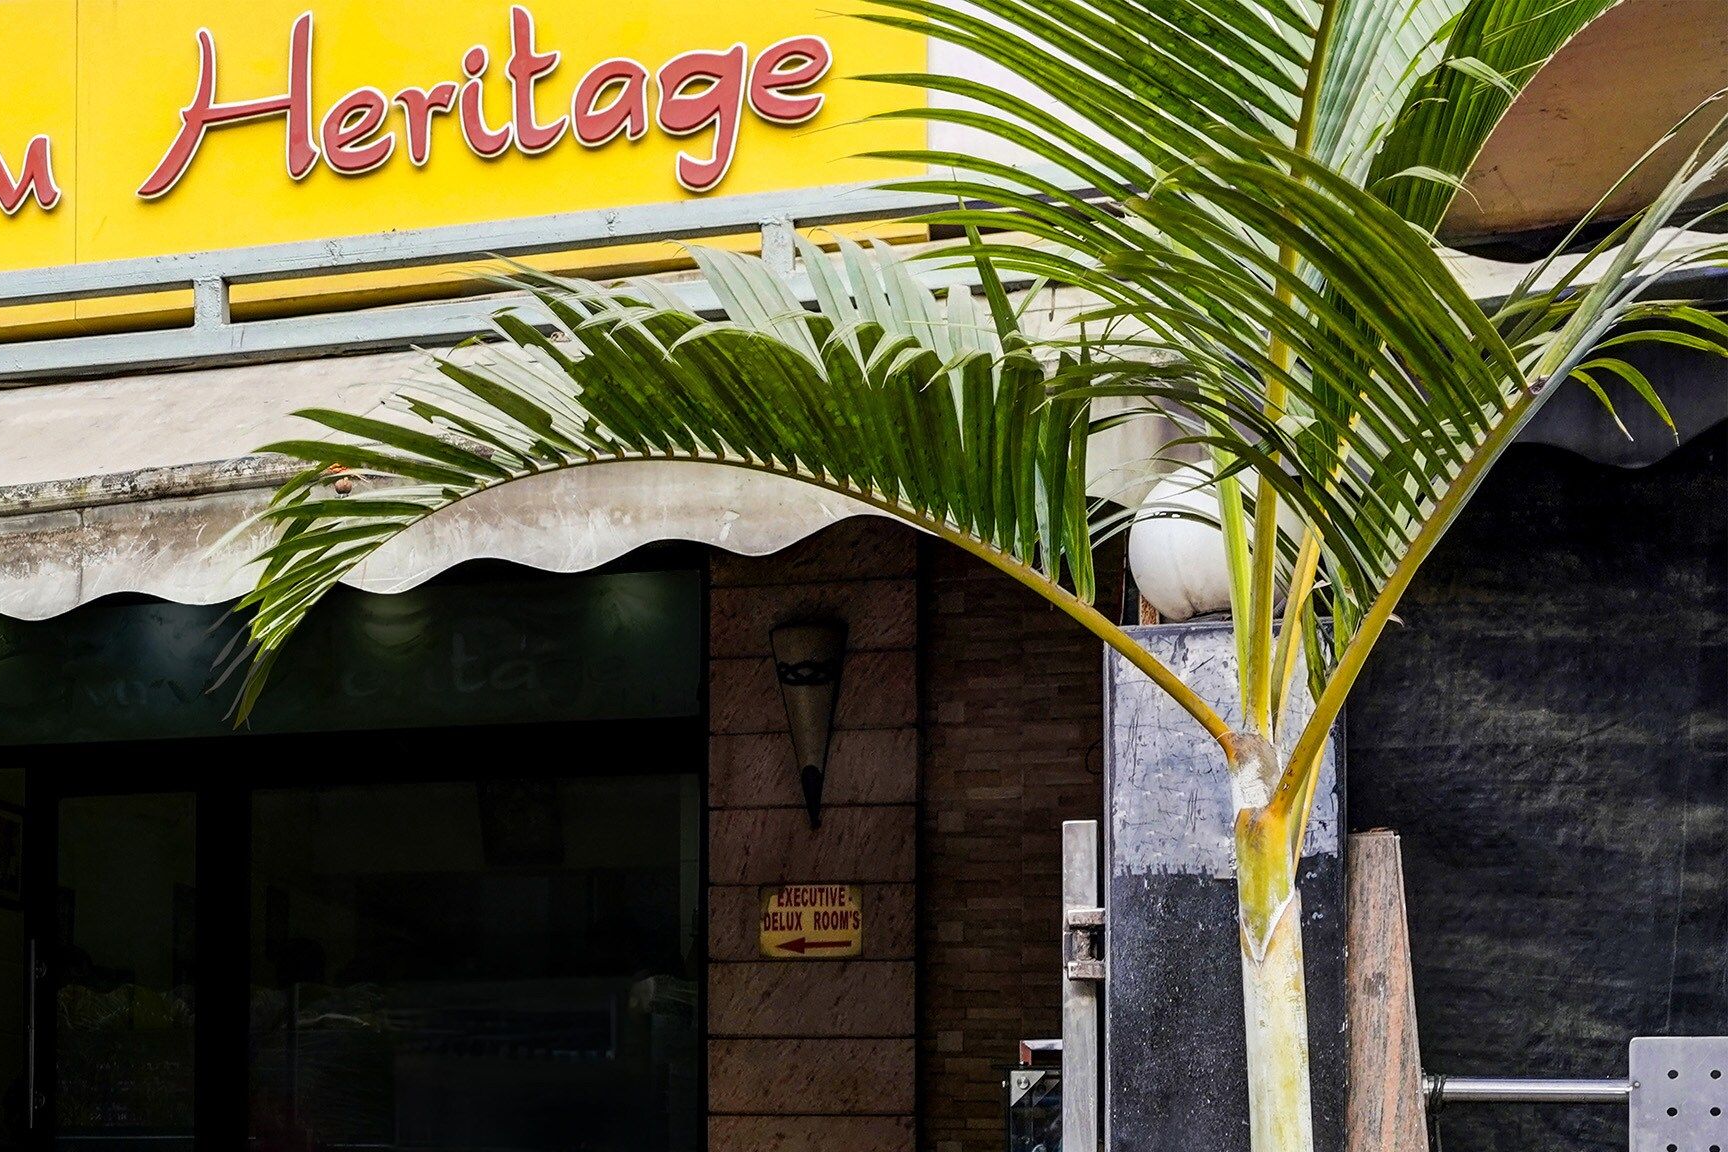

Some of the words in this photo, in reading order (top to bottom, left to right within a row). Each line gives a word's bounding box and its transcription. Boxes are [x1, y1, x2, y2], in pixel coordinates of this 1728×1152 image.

[135, 5, 834, 199] Heritage
[763, 911, 803, 931] DELUX
[813, 910, 861, 931] ROOM'S
